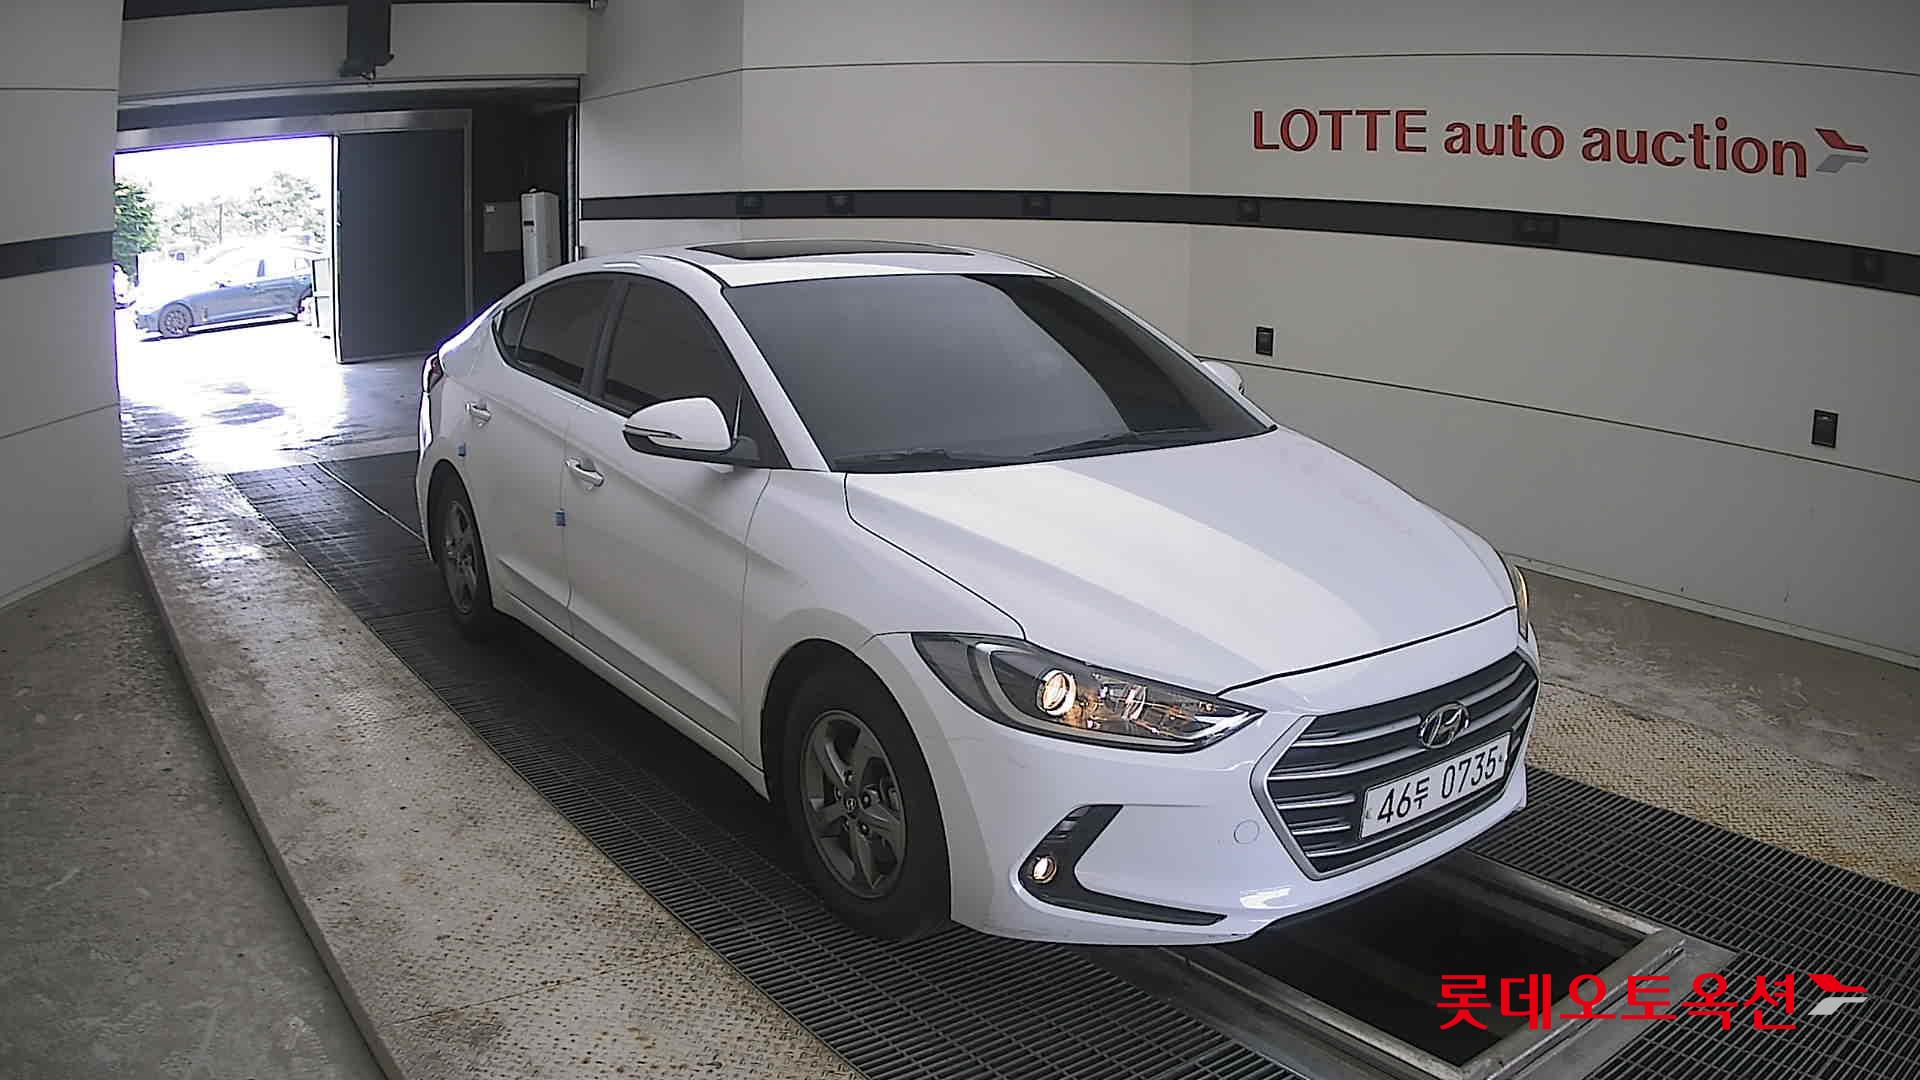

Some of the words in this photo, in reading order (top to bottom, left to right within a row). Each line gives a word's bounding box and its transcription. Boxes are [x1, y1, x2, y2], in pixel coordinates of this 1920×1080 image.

[1253, 108, 1428, 153] LOTTE
[1444, 113, 1566, 160] auto
[1581, 116, 1808, 178] auction
[1377, 776, 1431, 824] 46두
[1441, 745, 1499, 799] 0735
